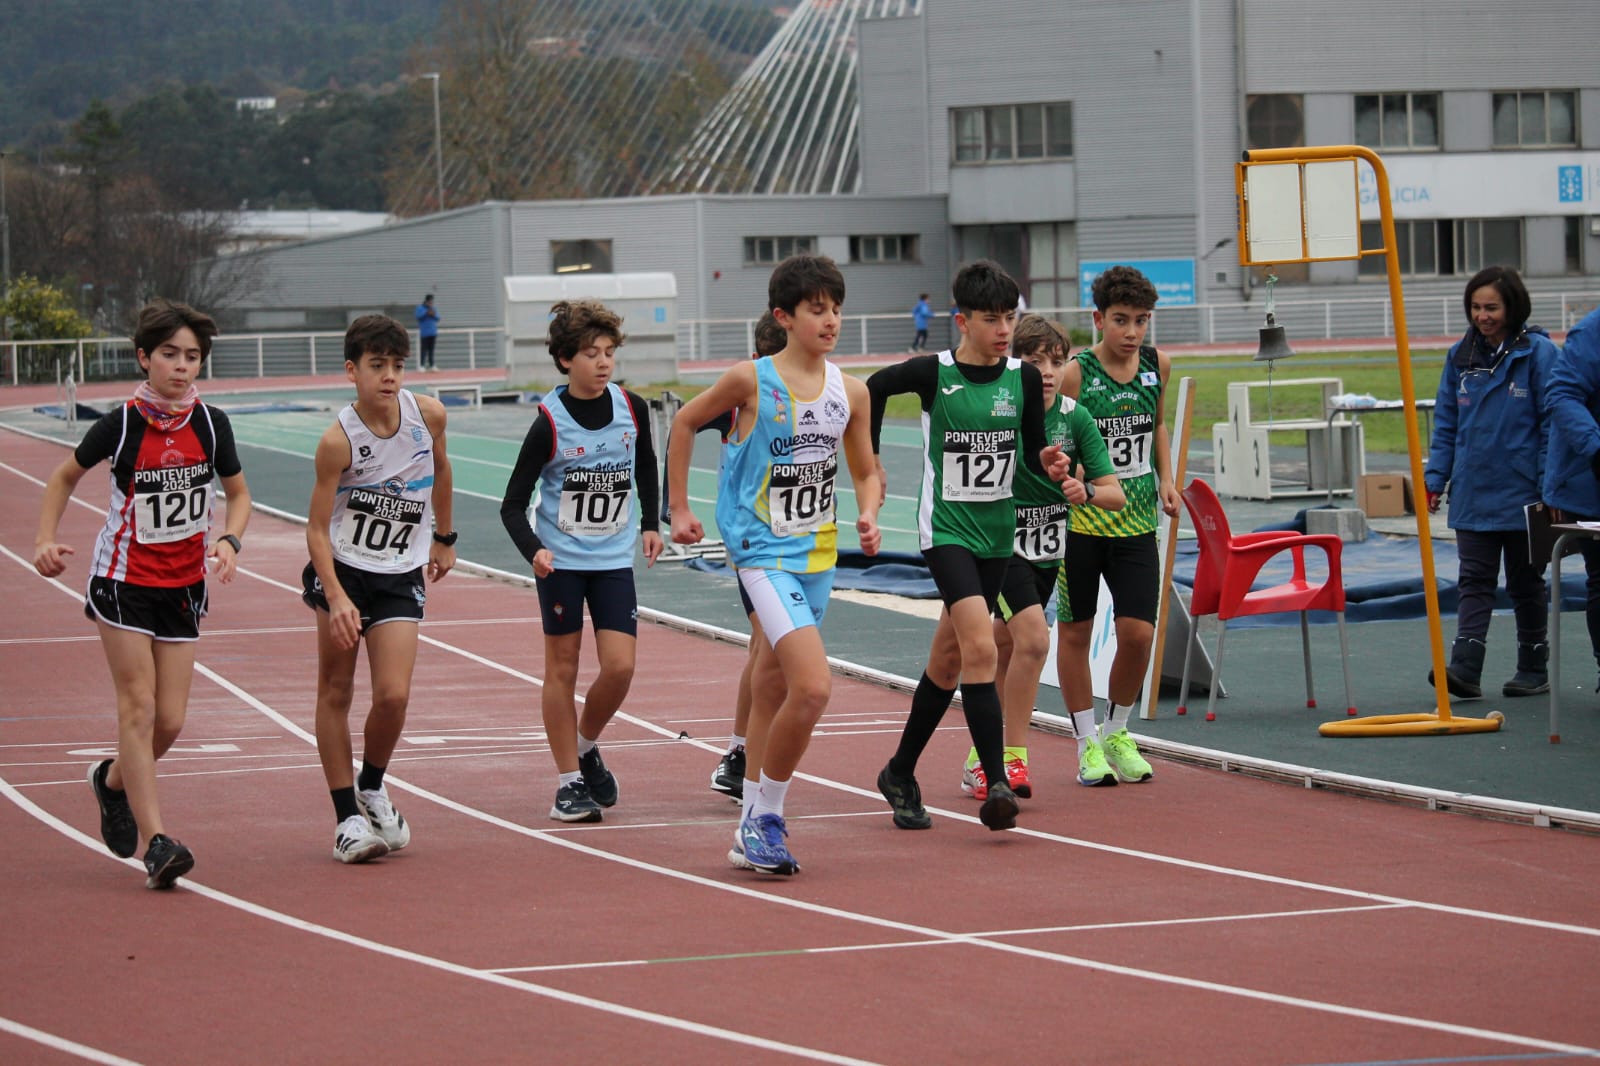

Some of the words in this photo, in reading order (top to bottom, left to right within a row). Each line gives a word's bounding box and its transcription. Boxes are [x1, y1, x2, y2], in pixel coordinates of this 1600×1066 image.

[1359, 186, 1430, 205] GICIA
[1110, 392, 1139, 402] LUCUS
[1095, 414, 1152, 429] NTEVEDRA
[945, 430, 1015, 443] PONTEVEDRA
[1107, 426, 1133, 437] 2025
[970, 442, 998, 453] 2025
[134, 463, 209, 484] PONTEVEDRA
[565, 470, 630, 483] PONTEVEDRA
[956, 452, 1011, 488] 127
[162, 478, 191, 492] 2025
[798, 471, 823, 486] 2025
[587, 482, 614, 491] 2025
[351, 489, 424, 514] PONTEVEDRA
[571, 491, 628, 523] 107
[779, 478, 834, 521] 108
[146, 487, 207, 529] 120
[373, 506, 402, 520] 2025
[1015, 504, 1067, 518] NTEVEDRA
[352, 513, 414, 555] 104
[1015, 523, 1060, 556] 113
